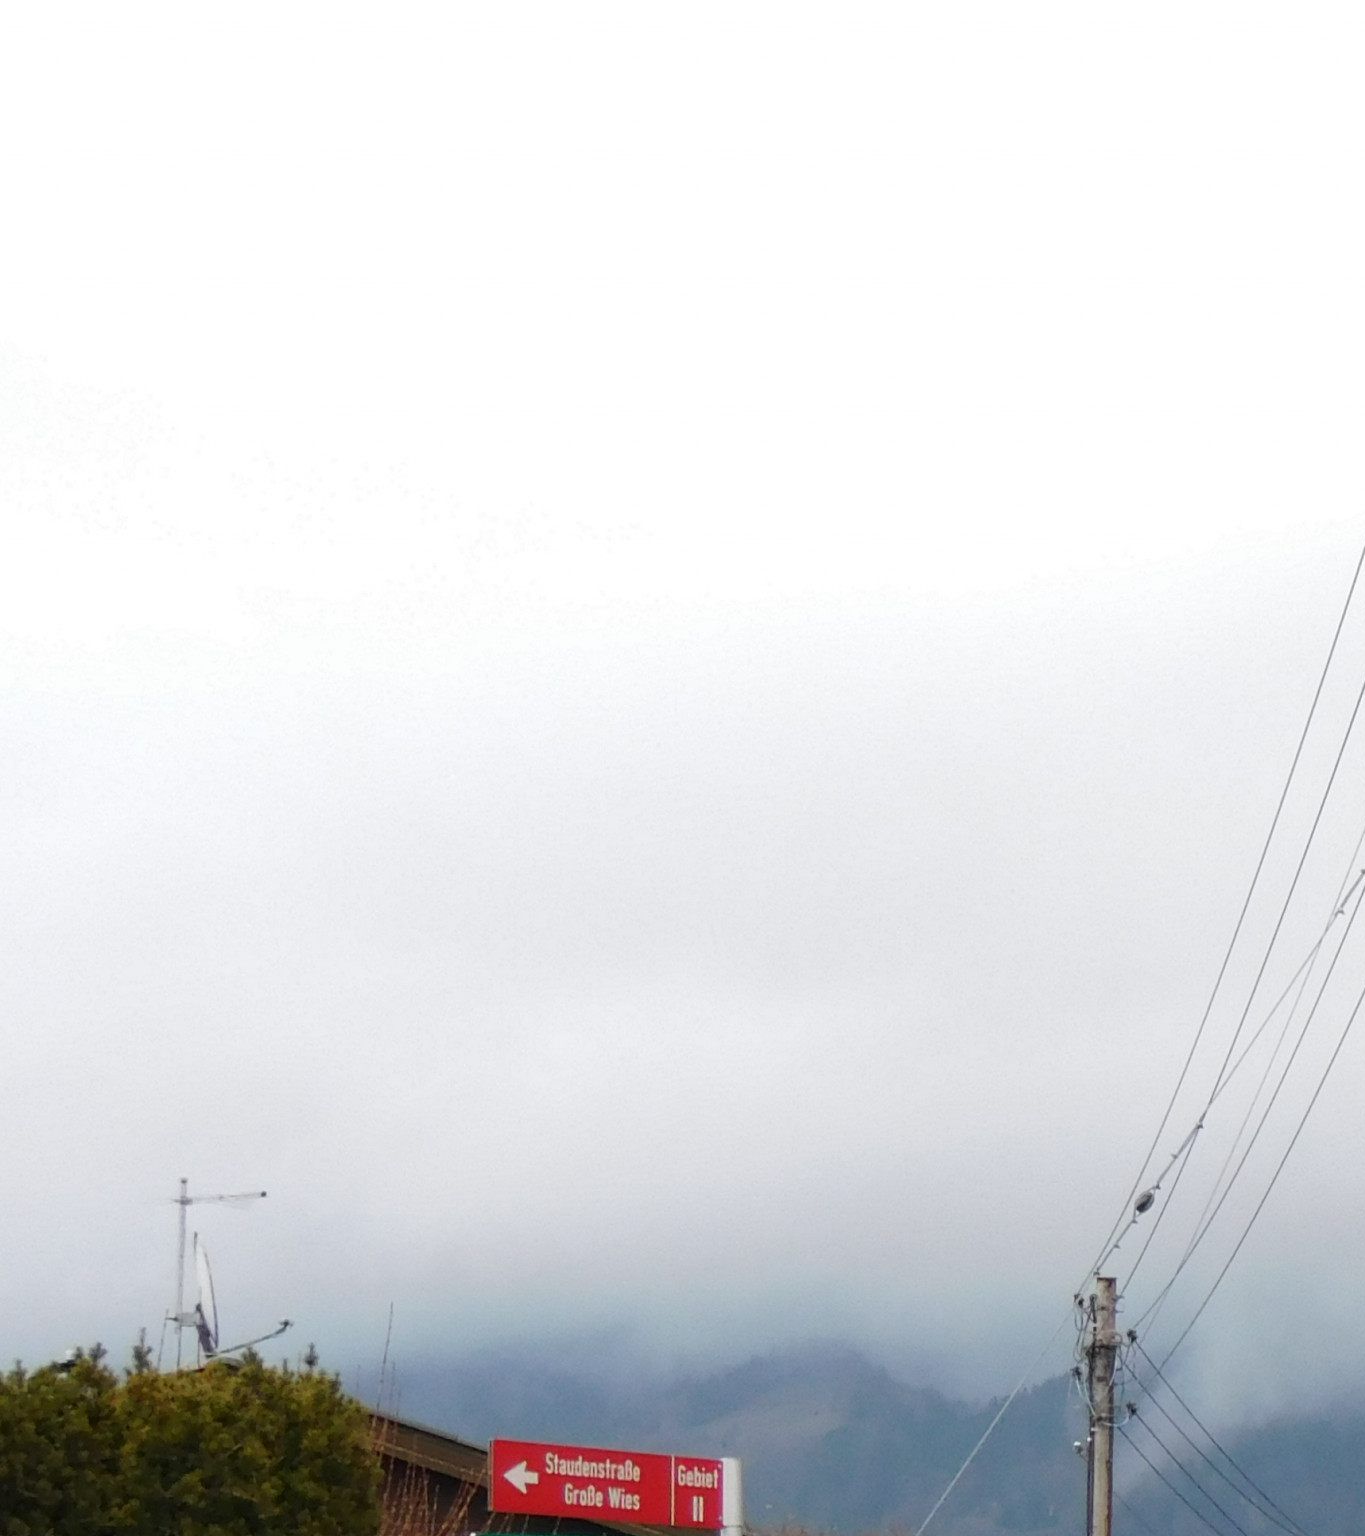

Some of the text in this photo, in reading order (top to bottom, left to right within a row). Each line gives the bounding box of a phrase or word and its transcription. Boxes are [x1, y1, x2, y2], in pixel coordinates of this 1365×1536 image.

[545, 1451, 641, 1482] Staudenstraße
[677, 1465, 718, 1489] Gebiet
[564, 1483, 640, 1511] Große Wies
[692, 1496, 705, 1522] II
